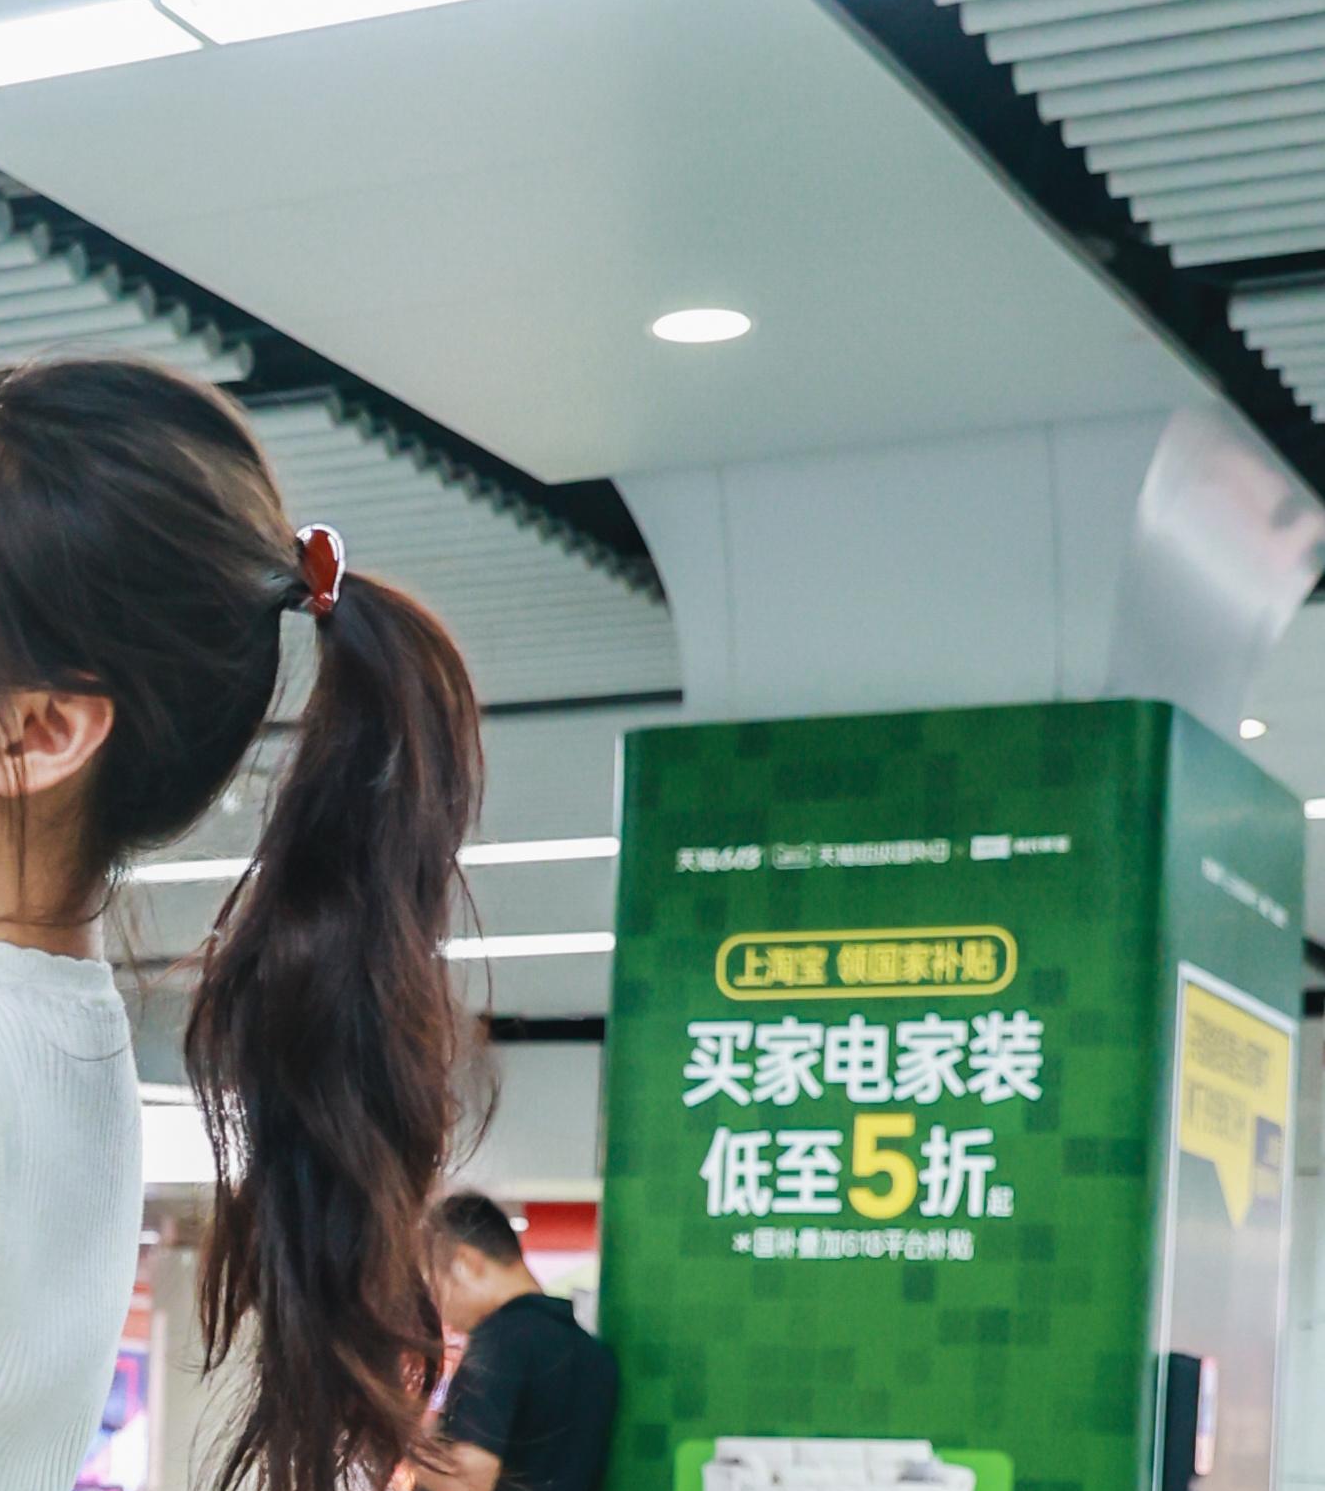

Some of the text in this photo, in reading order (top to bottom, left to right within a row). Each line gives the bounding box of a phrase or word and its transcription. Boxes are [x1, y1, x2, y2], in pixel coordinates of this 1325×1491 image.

[734, 945, 829, 987] 上淘宝
[682, 1011, 1044, 1107] 买家电家装
